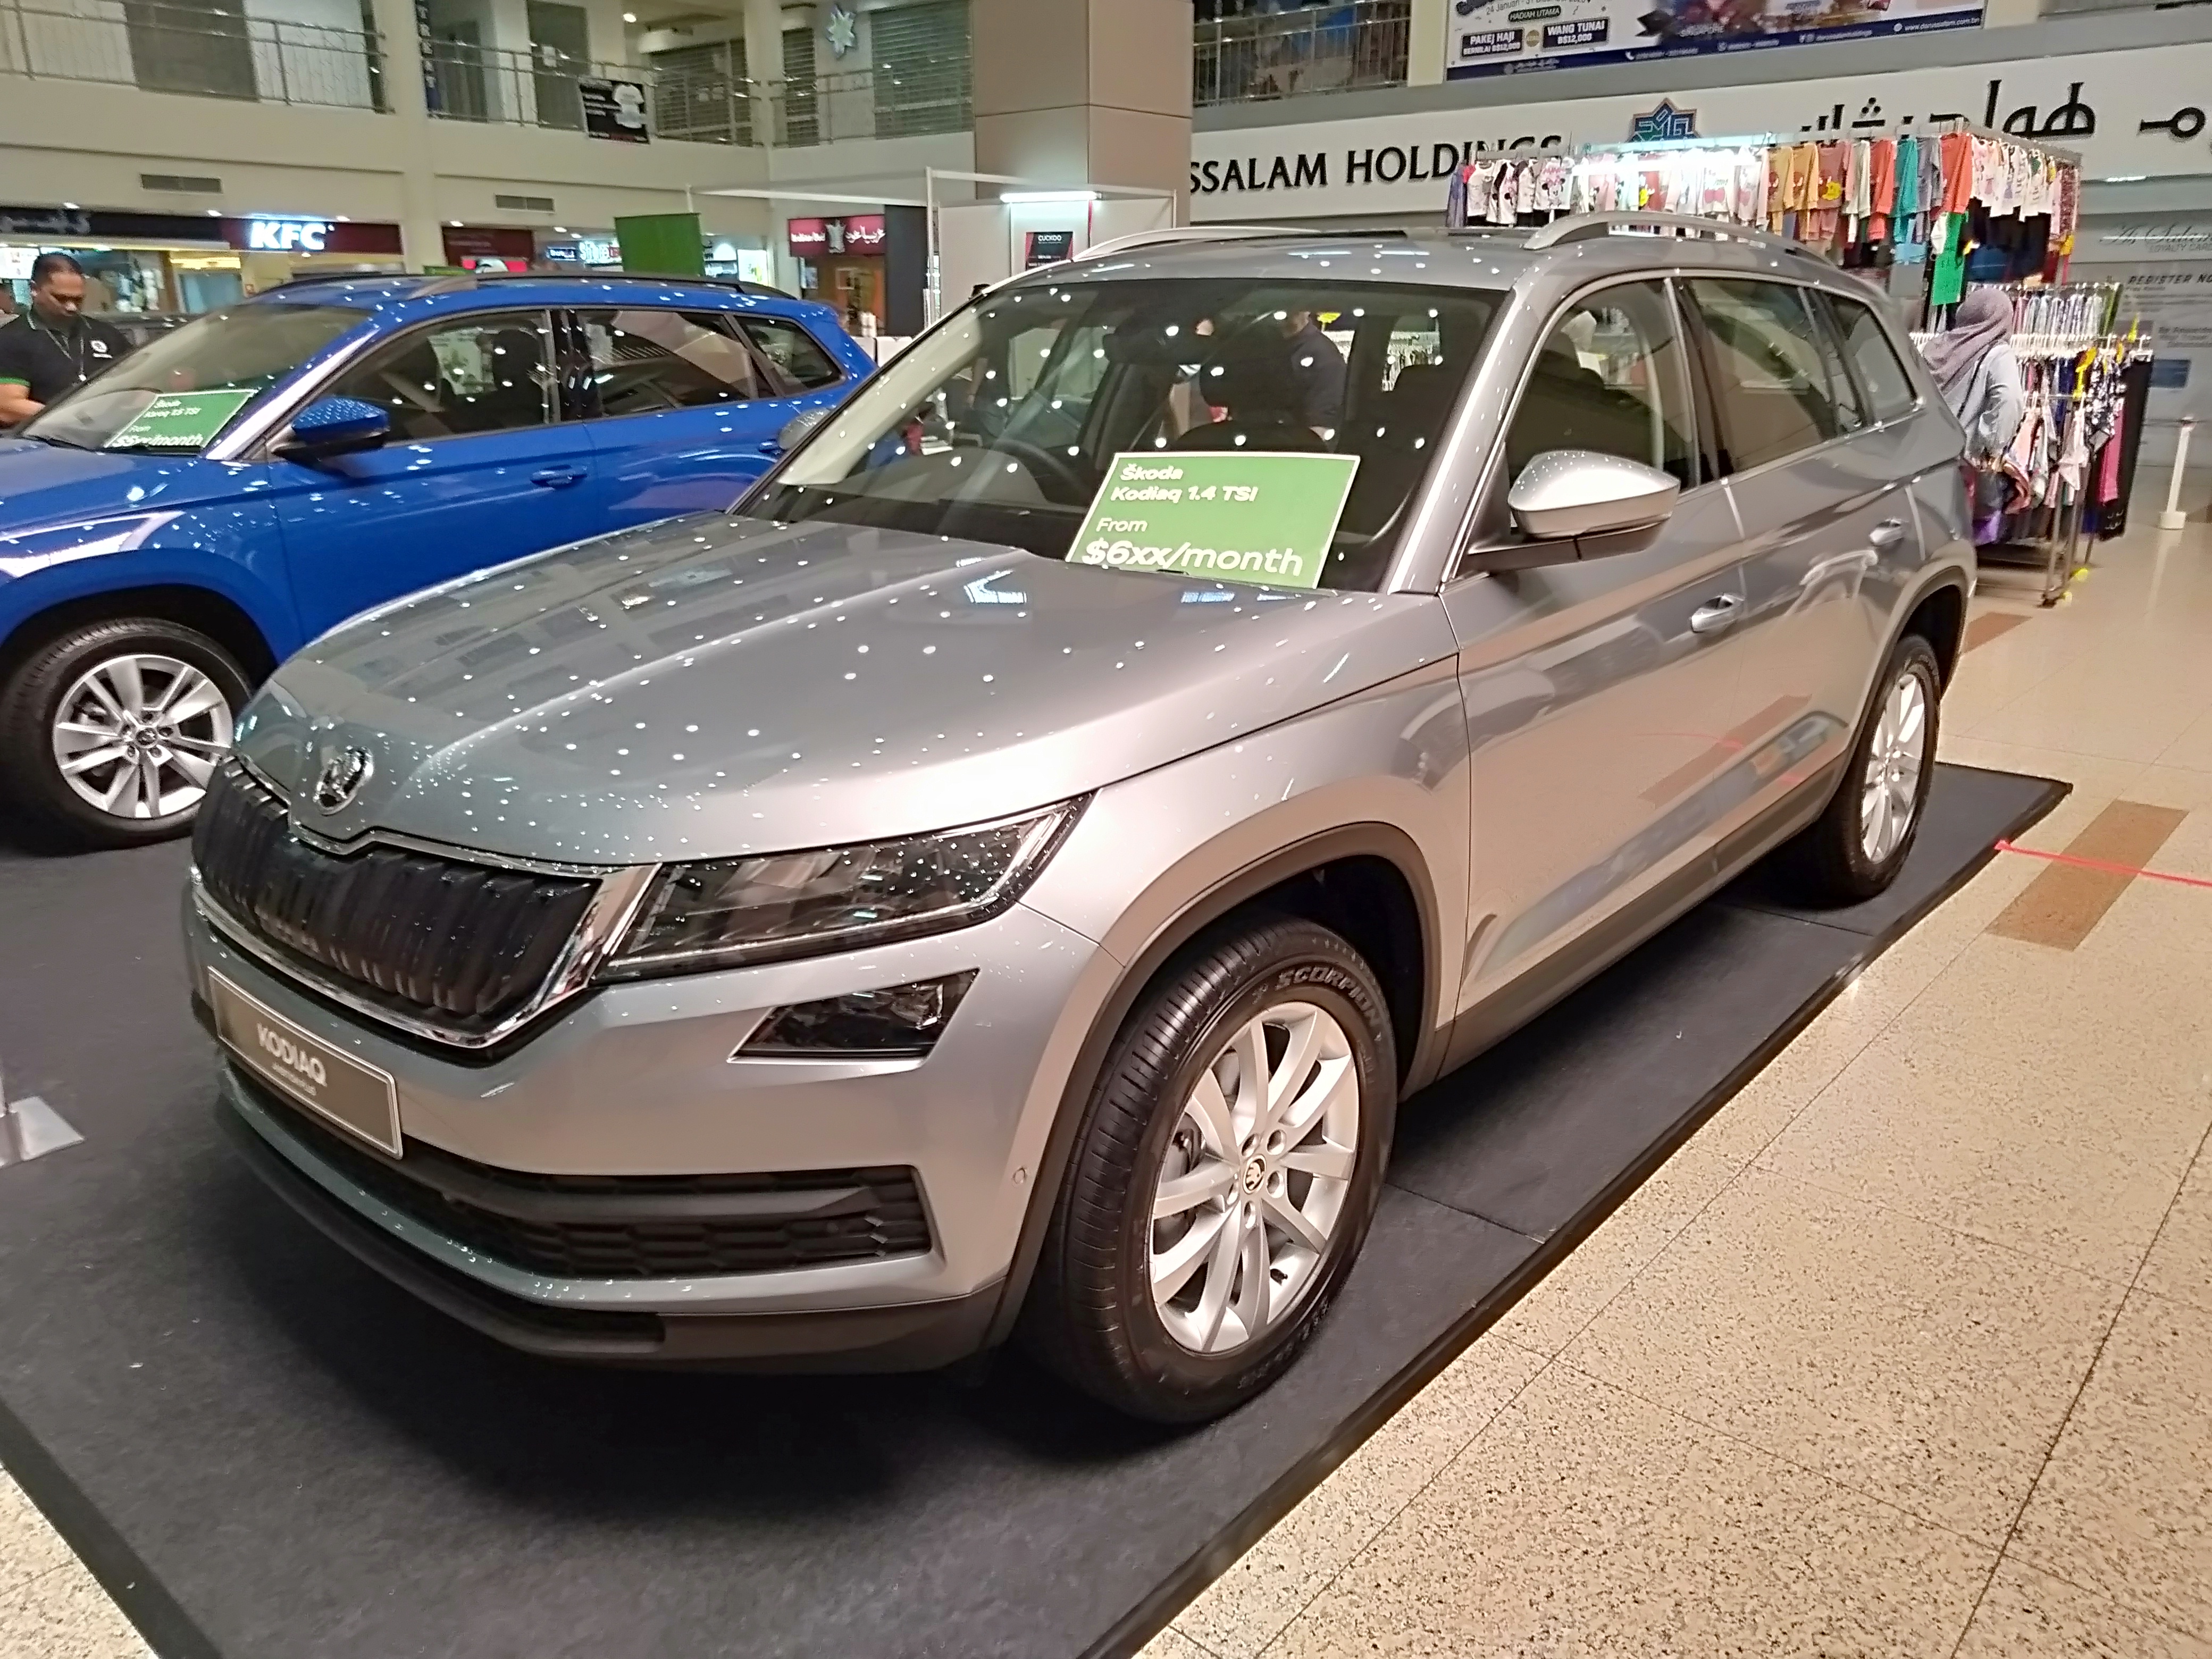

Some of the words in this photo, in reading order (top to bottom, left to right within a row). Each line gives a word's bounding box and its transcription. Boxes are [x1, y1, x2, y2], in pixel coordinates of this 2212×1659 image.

[1509, 11, 1536, 20] HADIAH
[1536, 8, 1560, 18] UTAMA
[1547, 24, 1576, 36] WANG
[1577, 20, 1605, 32] TUNAI
[1470, 33, 1495, 45] PAKEJ
[1496, 31, 1515, 42] HAJI
[1557, 33, 1592, 45] B$12,000
[1463, 47, 1492, 56] BERNILAI
[250, 222, 325, 250] KFC
[2128, 273, 2193, 284] REGISTER
[1120, 463, 1184, 481] Škoda
[1110, 485, 1183, 504] Kodiaq
[1188, 485, 1217, 501] 1.4
[1222, 485, 1259, 502] TSI
[1096, 517, 1149, 533] From
[1082, 537, 1303, 576] $6xx/month
[1275, 966, 1381, 1027] SCORPION
[256, 1022, 328, 1087] KODIAQ
